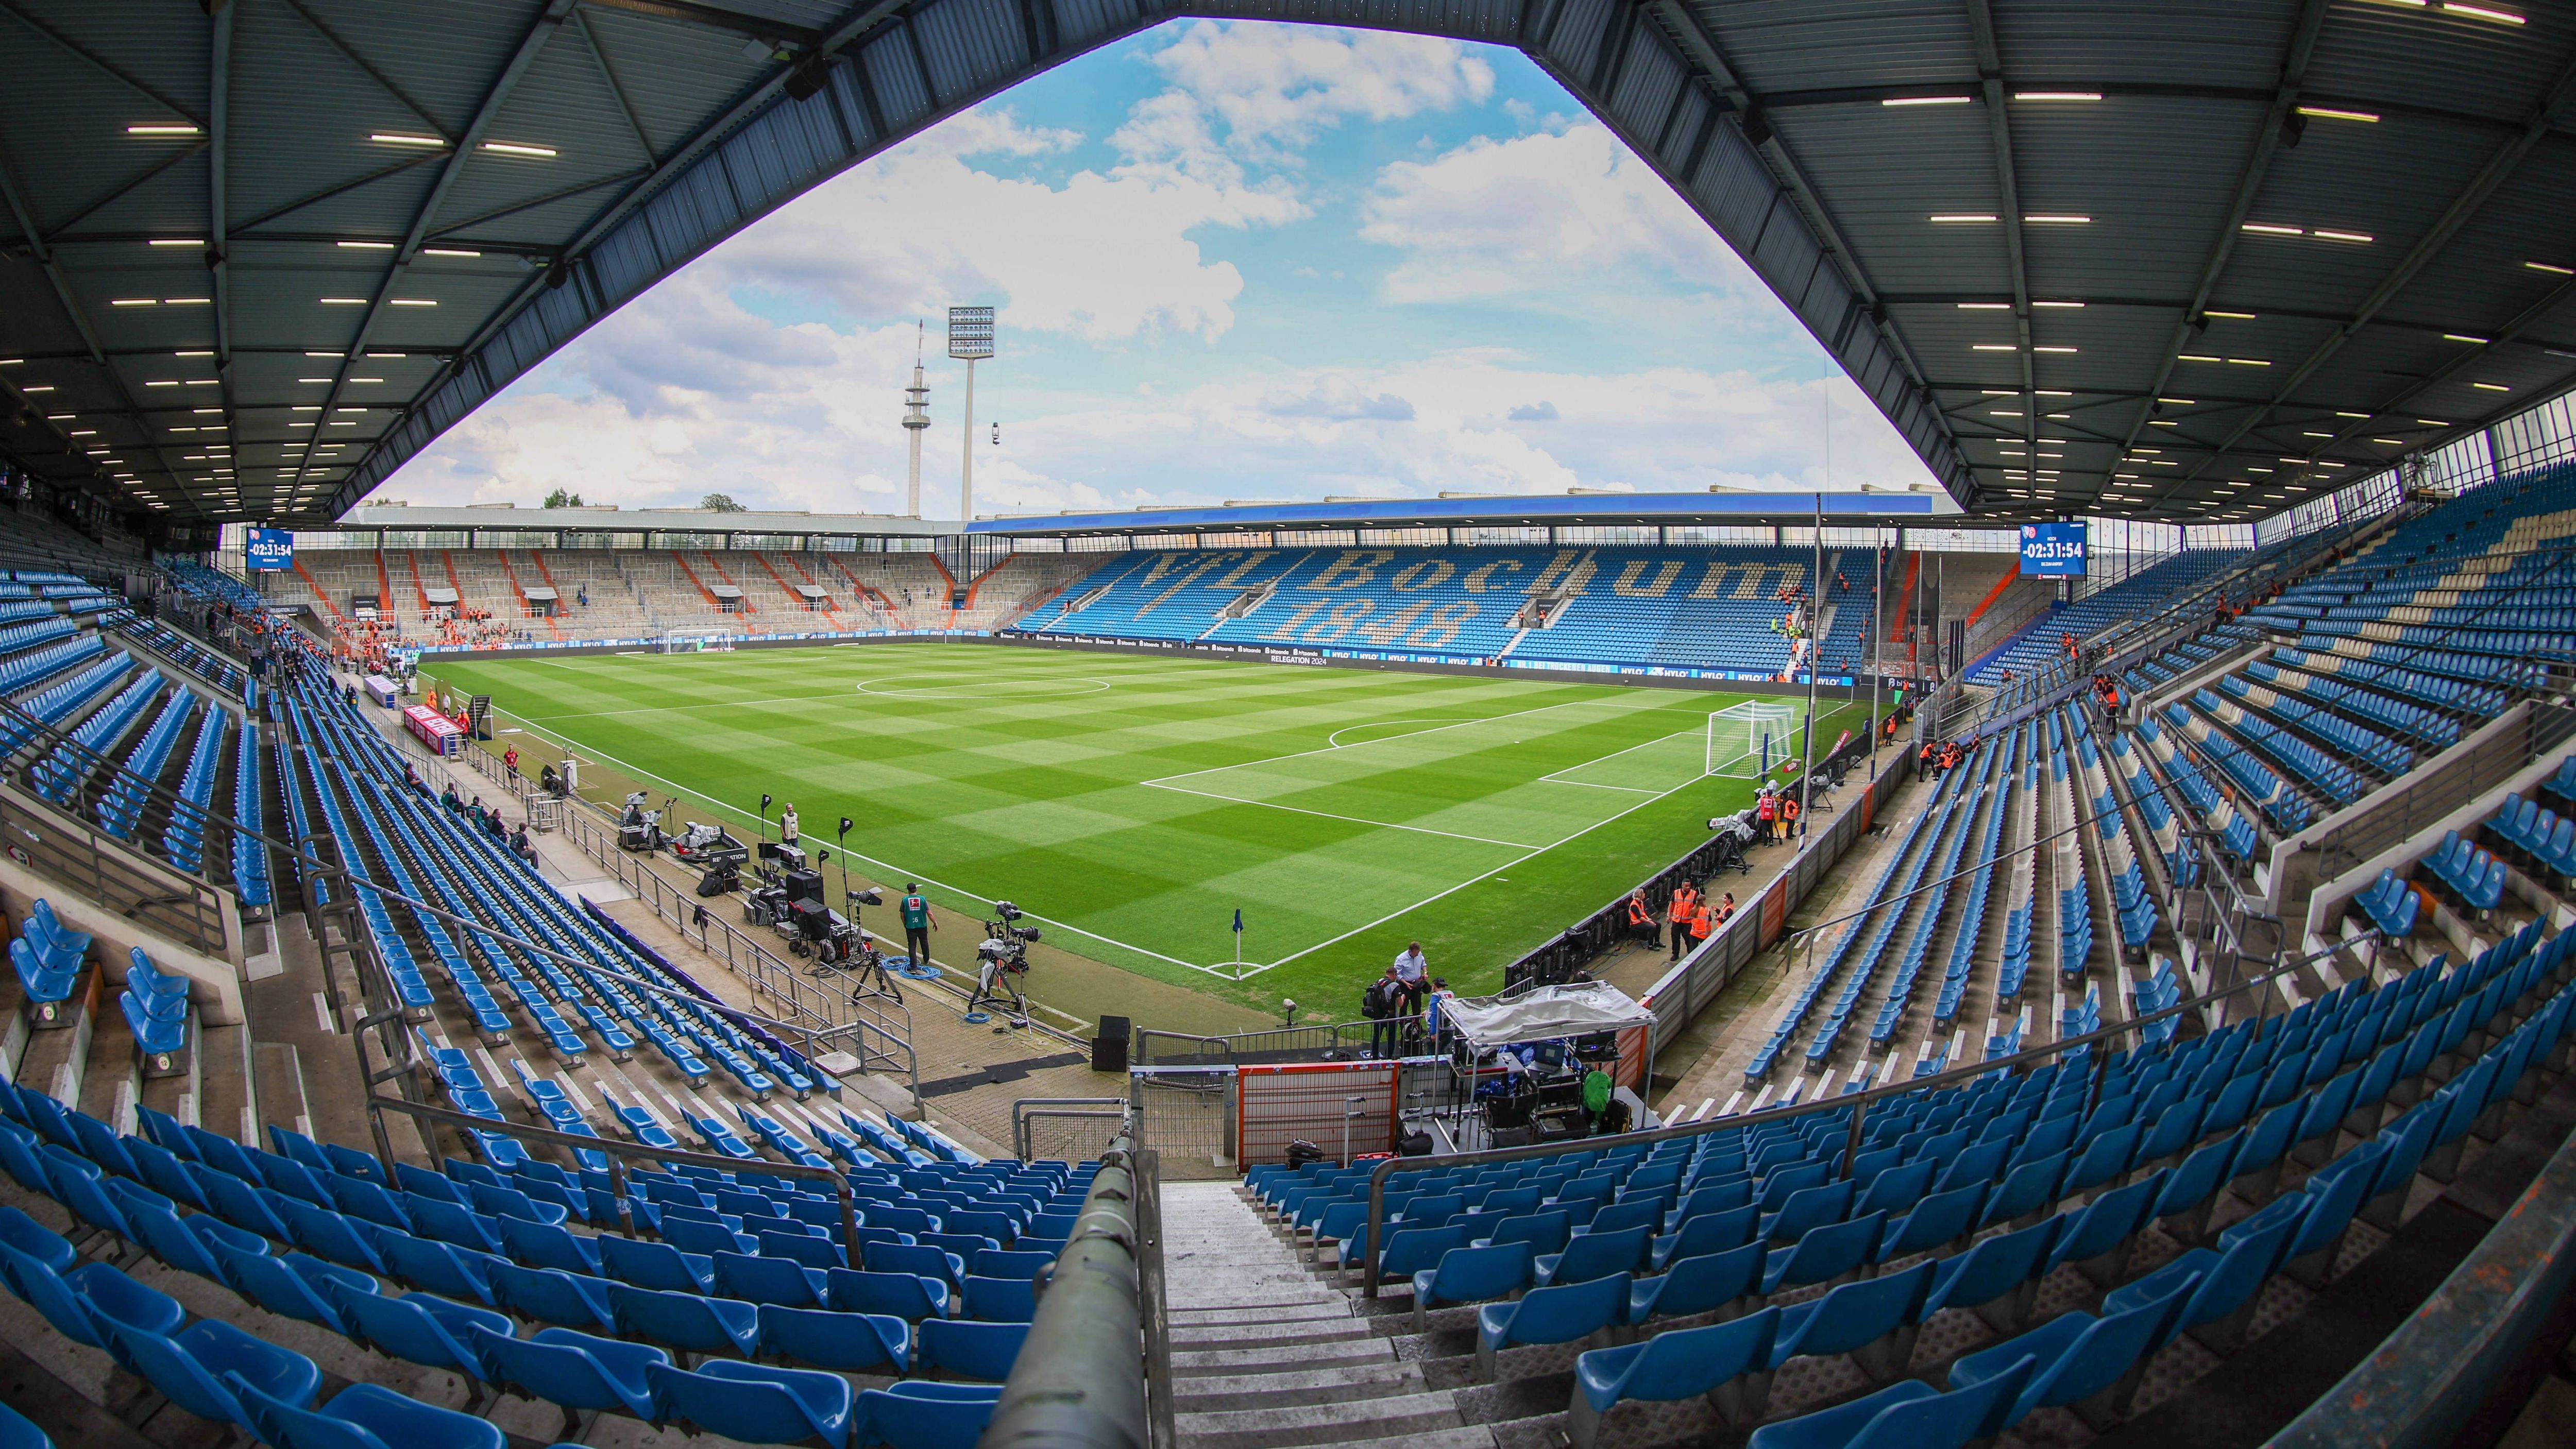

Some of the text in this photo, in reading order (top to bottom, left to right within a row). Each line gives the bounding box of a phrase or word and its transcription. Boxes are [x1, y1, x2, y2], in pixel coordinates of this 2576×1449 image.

[249, 543, 292, 556] -02:31:54
[2022, 542, 2082, 558] -02:31:54
[1261, 597, 1481, 647] 1848
[1271, 655, 1310, 664] RELEGATION
[713, 853, 747, 863] REATION
